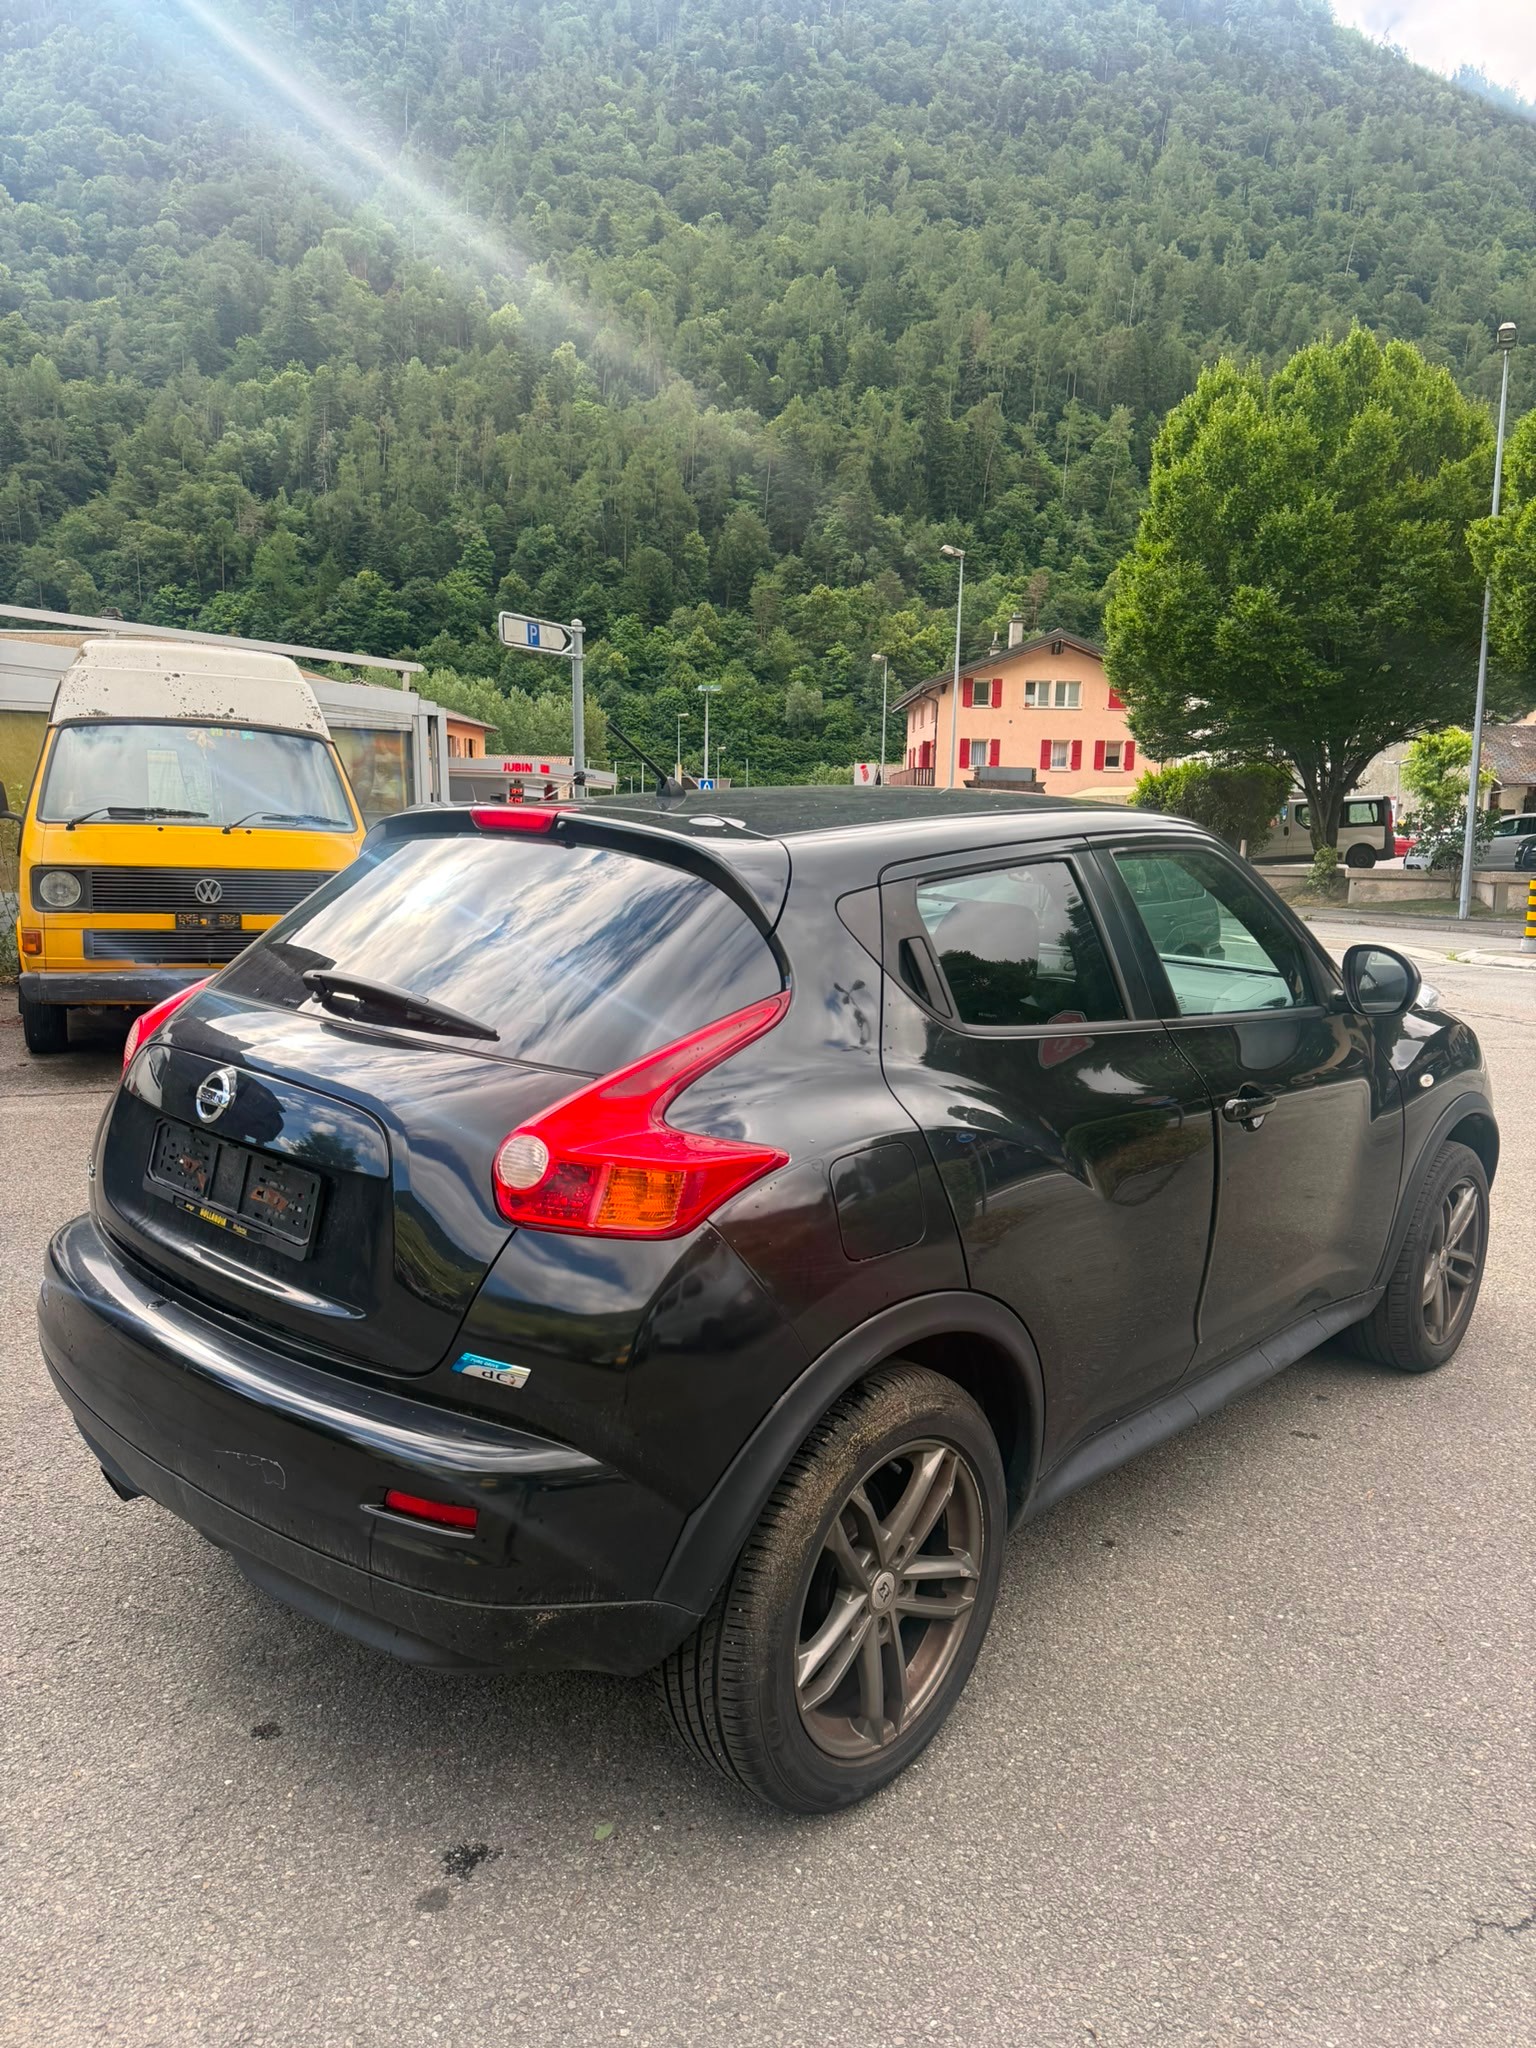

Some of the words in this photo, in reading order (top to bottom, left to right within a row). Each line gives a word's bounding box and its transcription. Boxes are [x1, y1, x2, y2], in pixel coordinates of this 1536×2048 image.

[530, 625, 537, 643] P
[503, 763, 533, 772] JUBIN
[197, 880, 221, 902] VW
